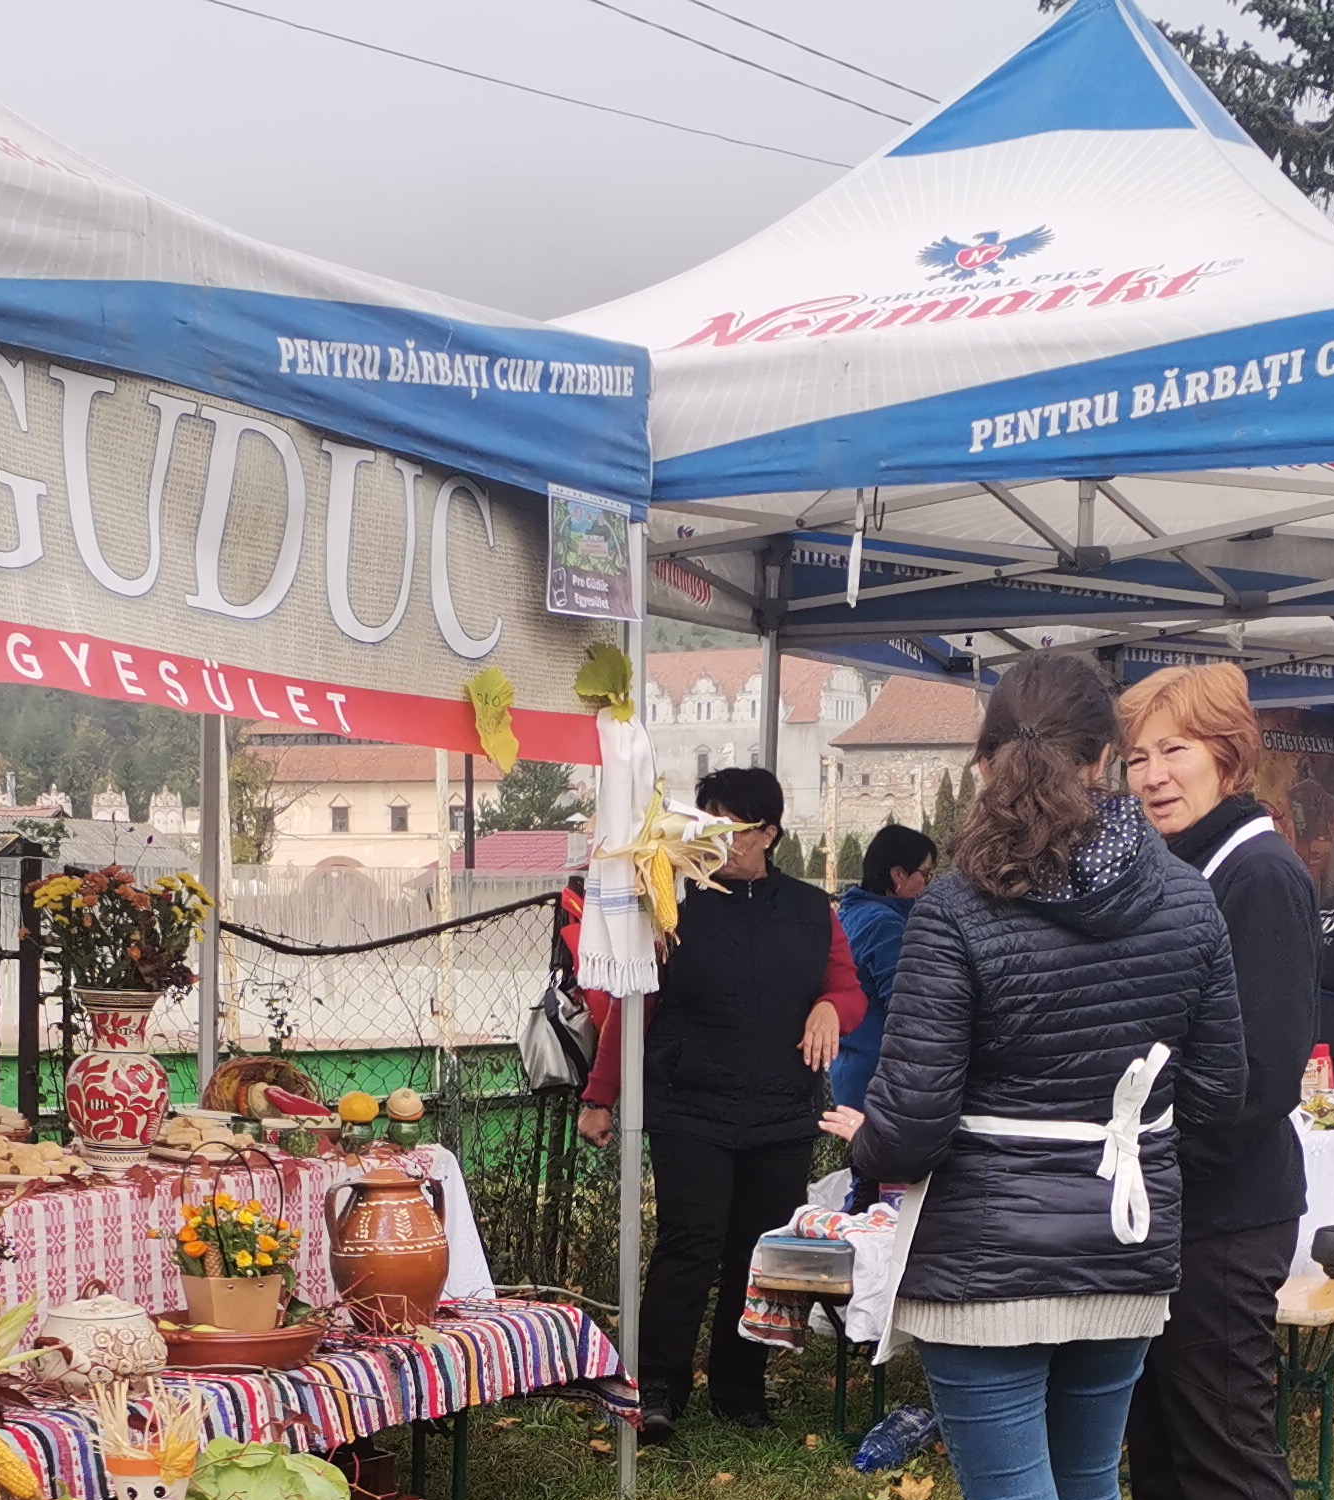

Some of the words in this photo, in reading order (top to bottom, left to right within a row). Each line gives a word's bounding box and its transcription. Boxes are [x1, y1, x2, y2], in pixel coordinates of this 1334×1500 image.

[672, 260, 1217, 350] Neumarkt
[870, 278, 1024, 306] ORIGINAL
[1031, 267, 1104, 286] PILS
[277, 337, 381, 380] PENTRU
[388, 339, 489, 399] BĂRBAȚI
[493, 356, 541, 393] CUM
[549, 361, 635, 398] TREBUIE
[968, 390, 1120, 454] PENTRU
[1129, 347, 1306, 421] BĂRBAȚI
